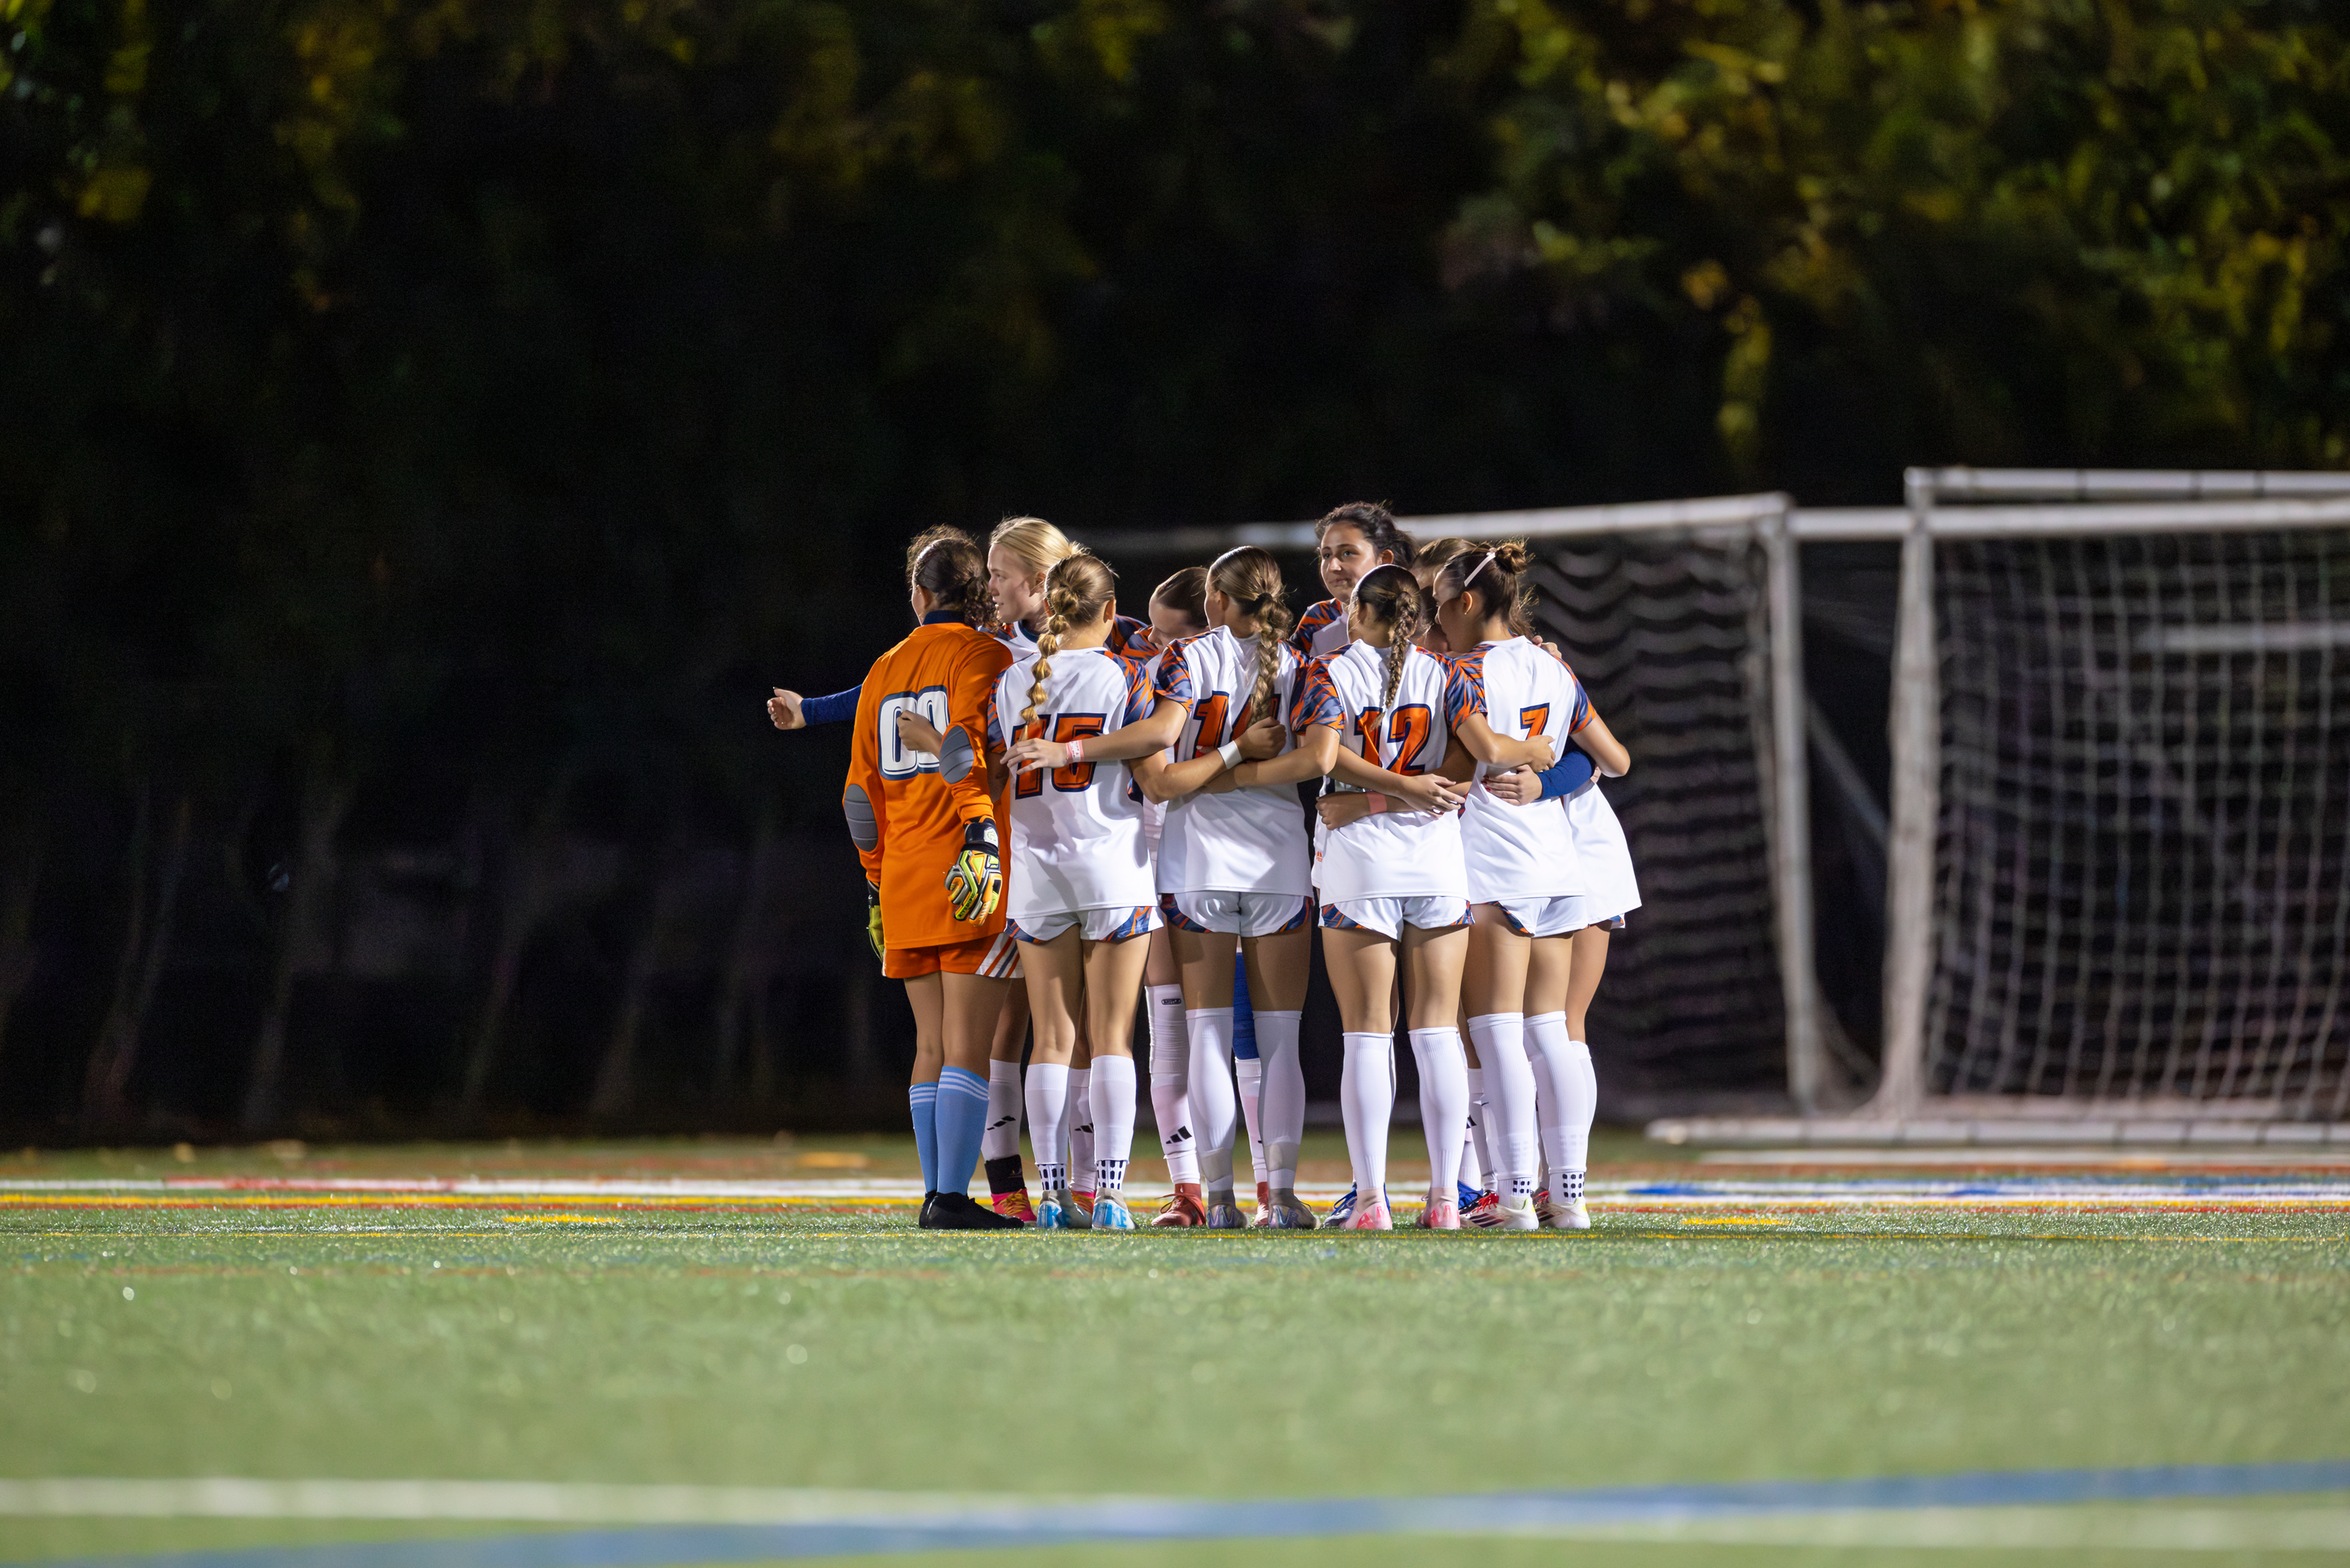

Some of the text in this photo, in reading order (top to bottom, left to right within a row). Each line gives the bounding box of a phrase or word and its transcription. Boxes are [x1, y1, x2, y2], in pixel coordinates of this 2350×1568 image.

[1010, 713, 1107, 800] 15
[1353, 703, 1432, 777] 12
[1520, 702, 1550, 740] 7
